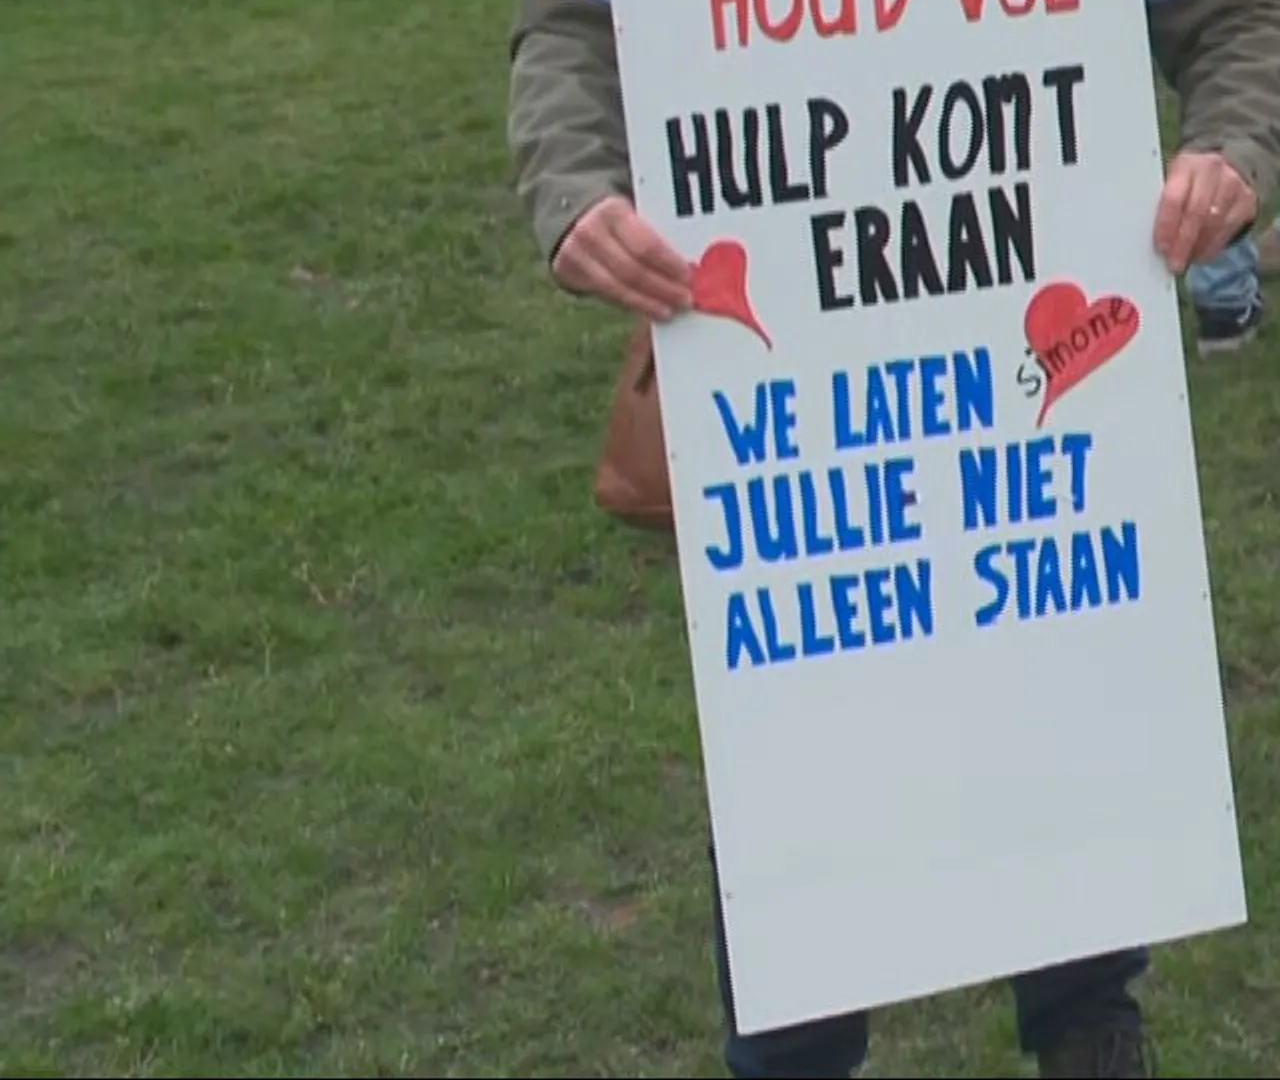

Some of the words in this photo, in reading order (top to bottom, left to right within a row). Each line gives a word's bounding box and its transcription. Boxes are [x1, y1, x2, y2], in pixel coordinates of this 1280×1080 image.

[665, 97, 849, 217] HULP
[891, 65, 1085, 187] KOMT
[810, 184, 1037, 312] ERAAN
[712, 380, 799, 465] WE
[831, 347, 994, 450] LATEN
[704, 458, 922, 572] JULLIE
[959, 432, 1093, 531] NIET
[725, 558, 933, 670] ALLEEN
[973, 521, 1142, 626] STAAN
